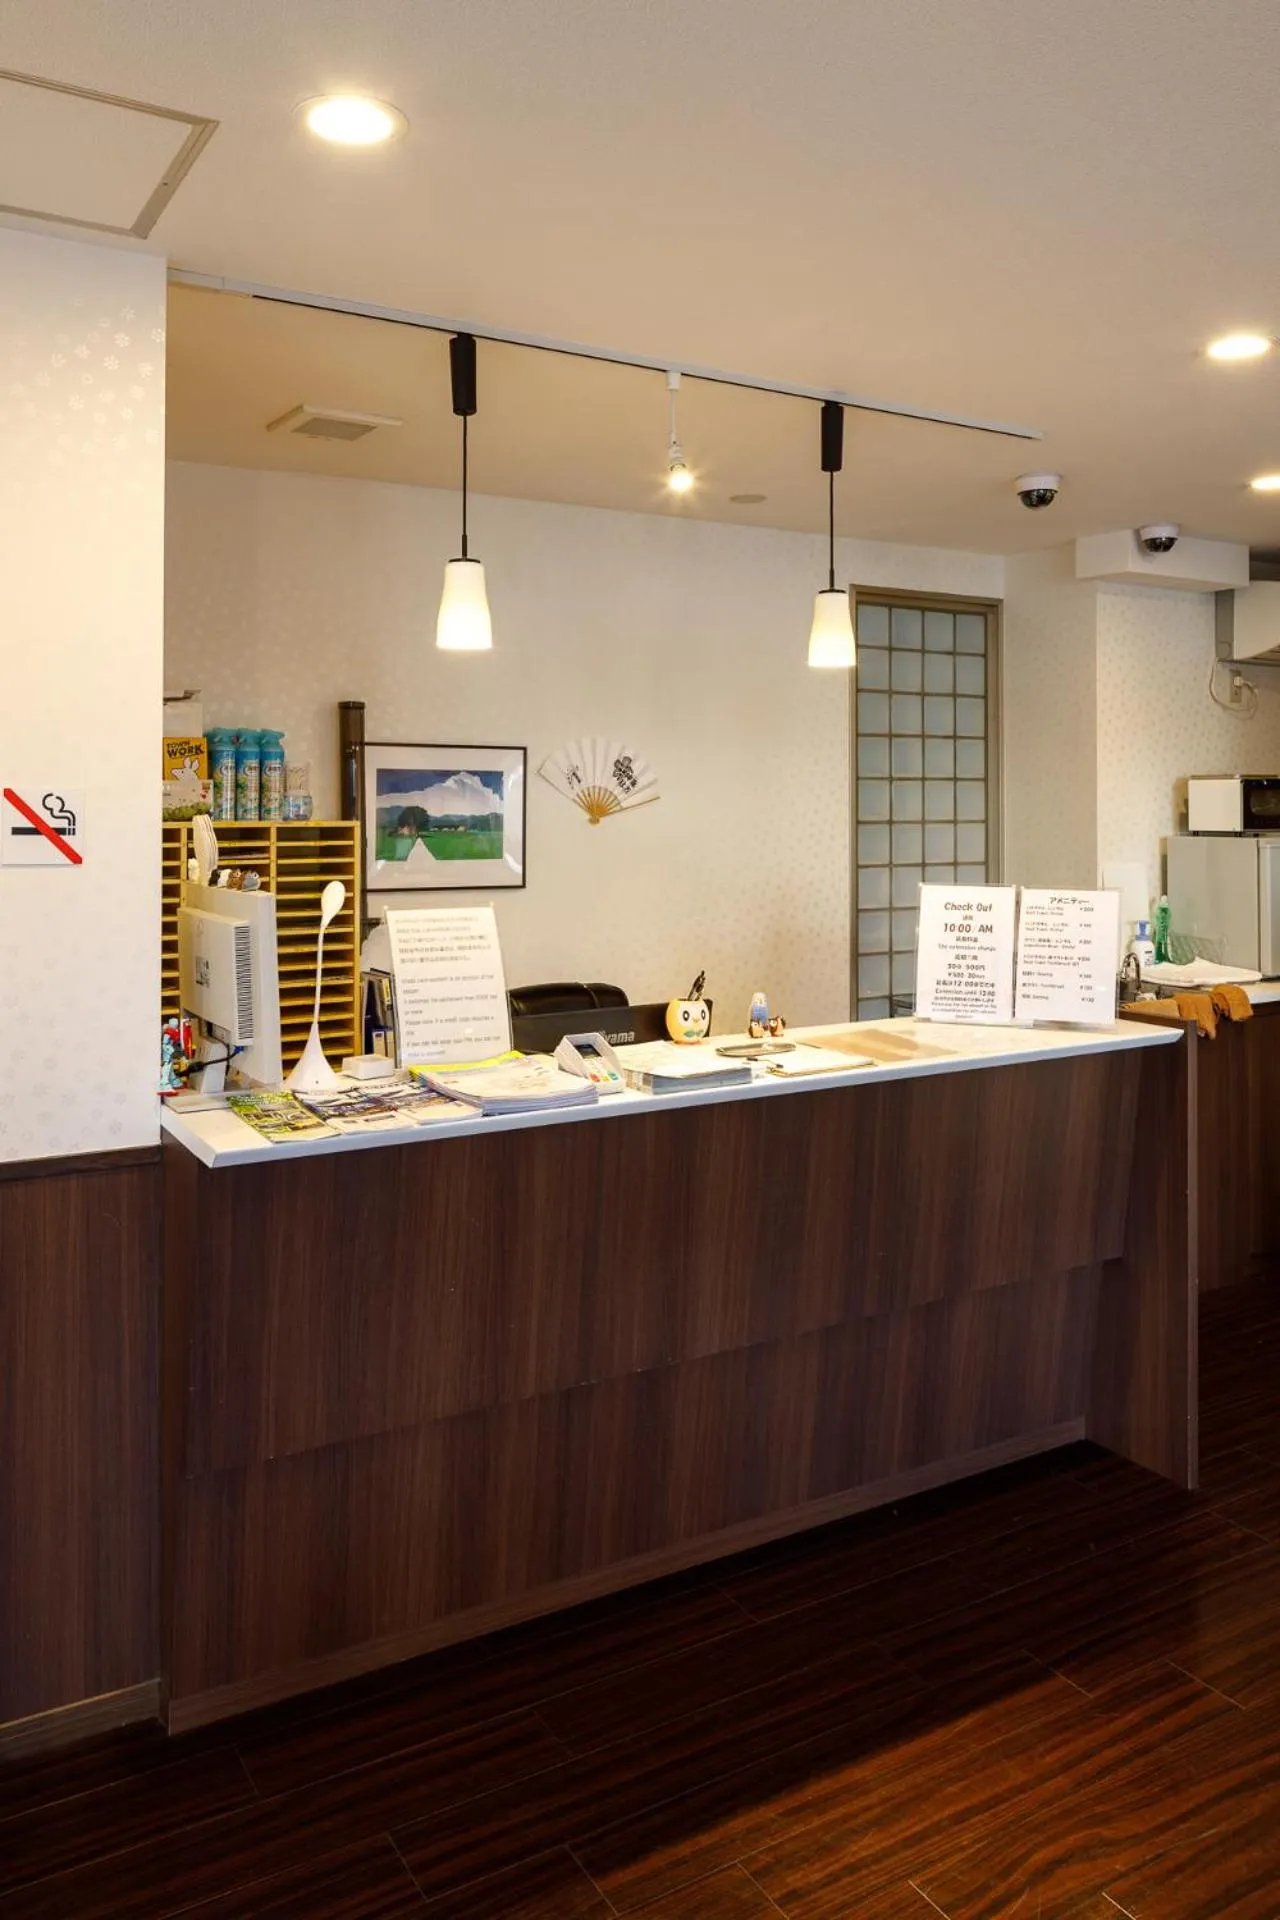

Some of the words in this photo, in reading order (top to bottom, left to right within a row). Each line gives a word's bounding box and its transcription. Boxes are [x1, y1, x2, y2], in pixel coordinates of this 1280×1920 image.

[167, 741, 190, 749] TOWN
[167, 745, 204, 758] WORK
[1048, 896, 1090, 905] アメニティー
[943, 902, 973, 911] Check
[975, 902, 993, 912] Out
[978, 924, 993, 933] AM
